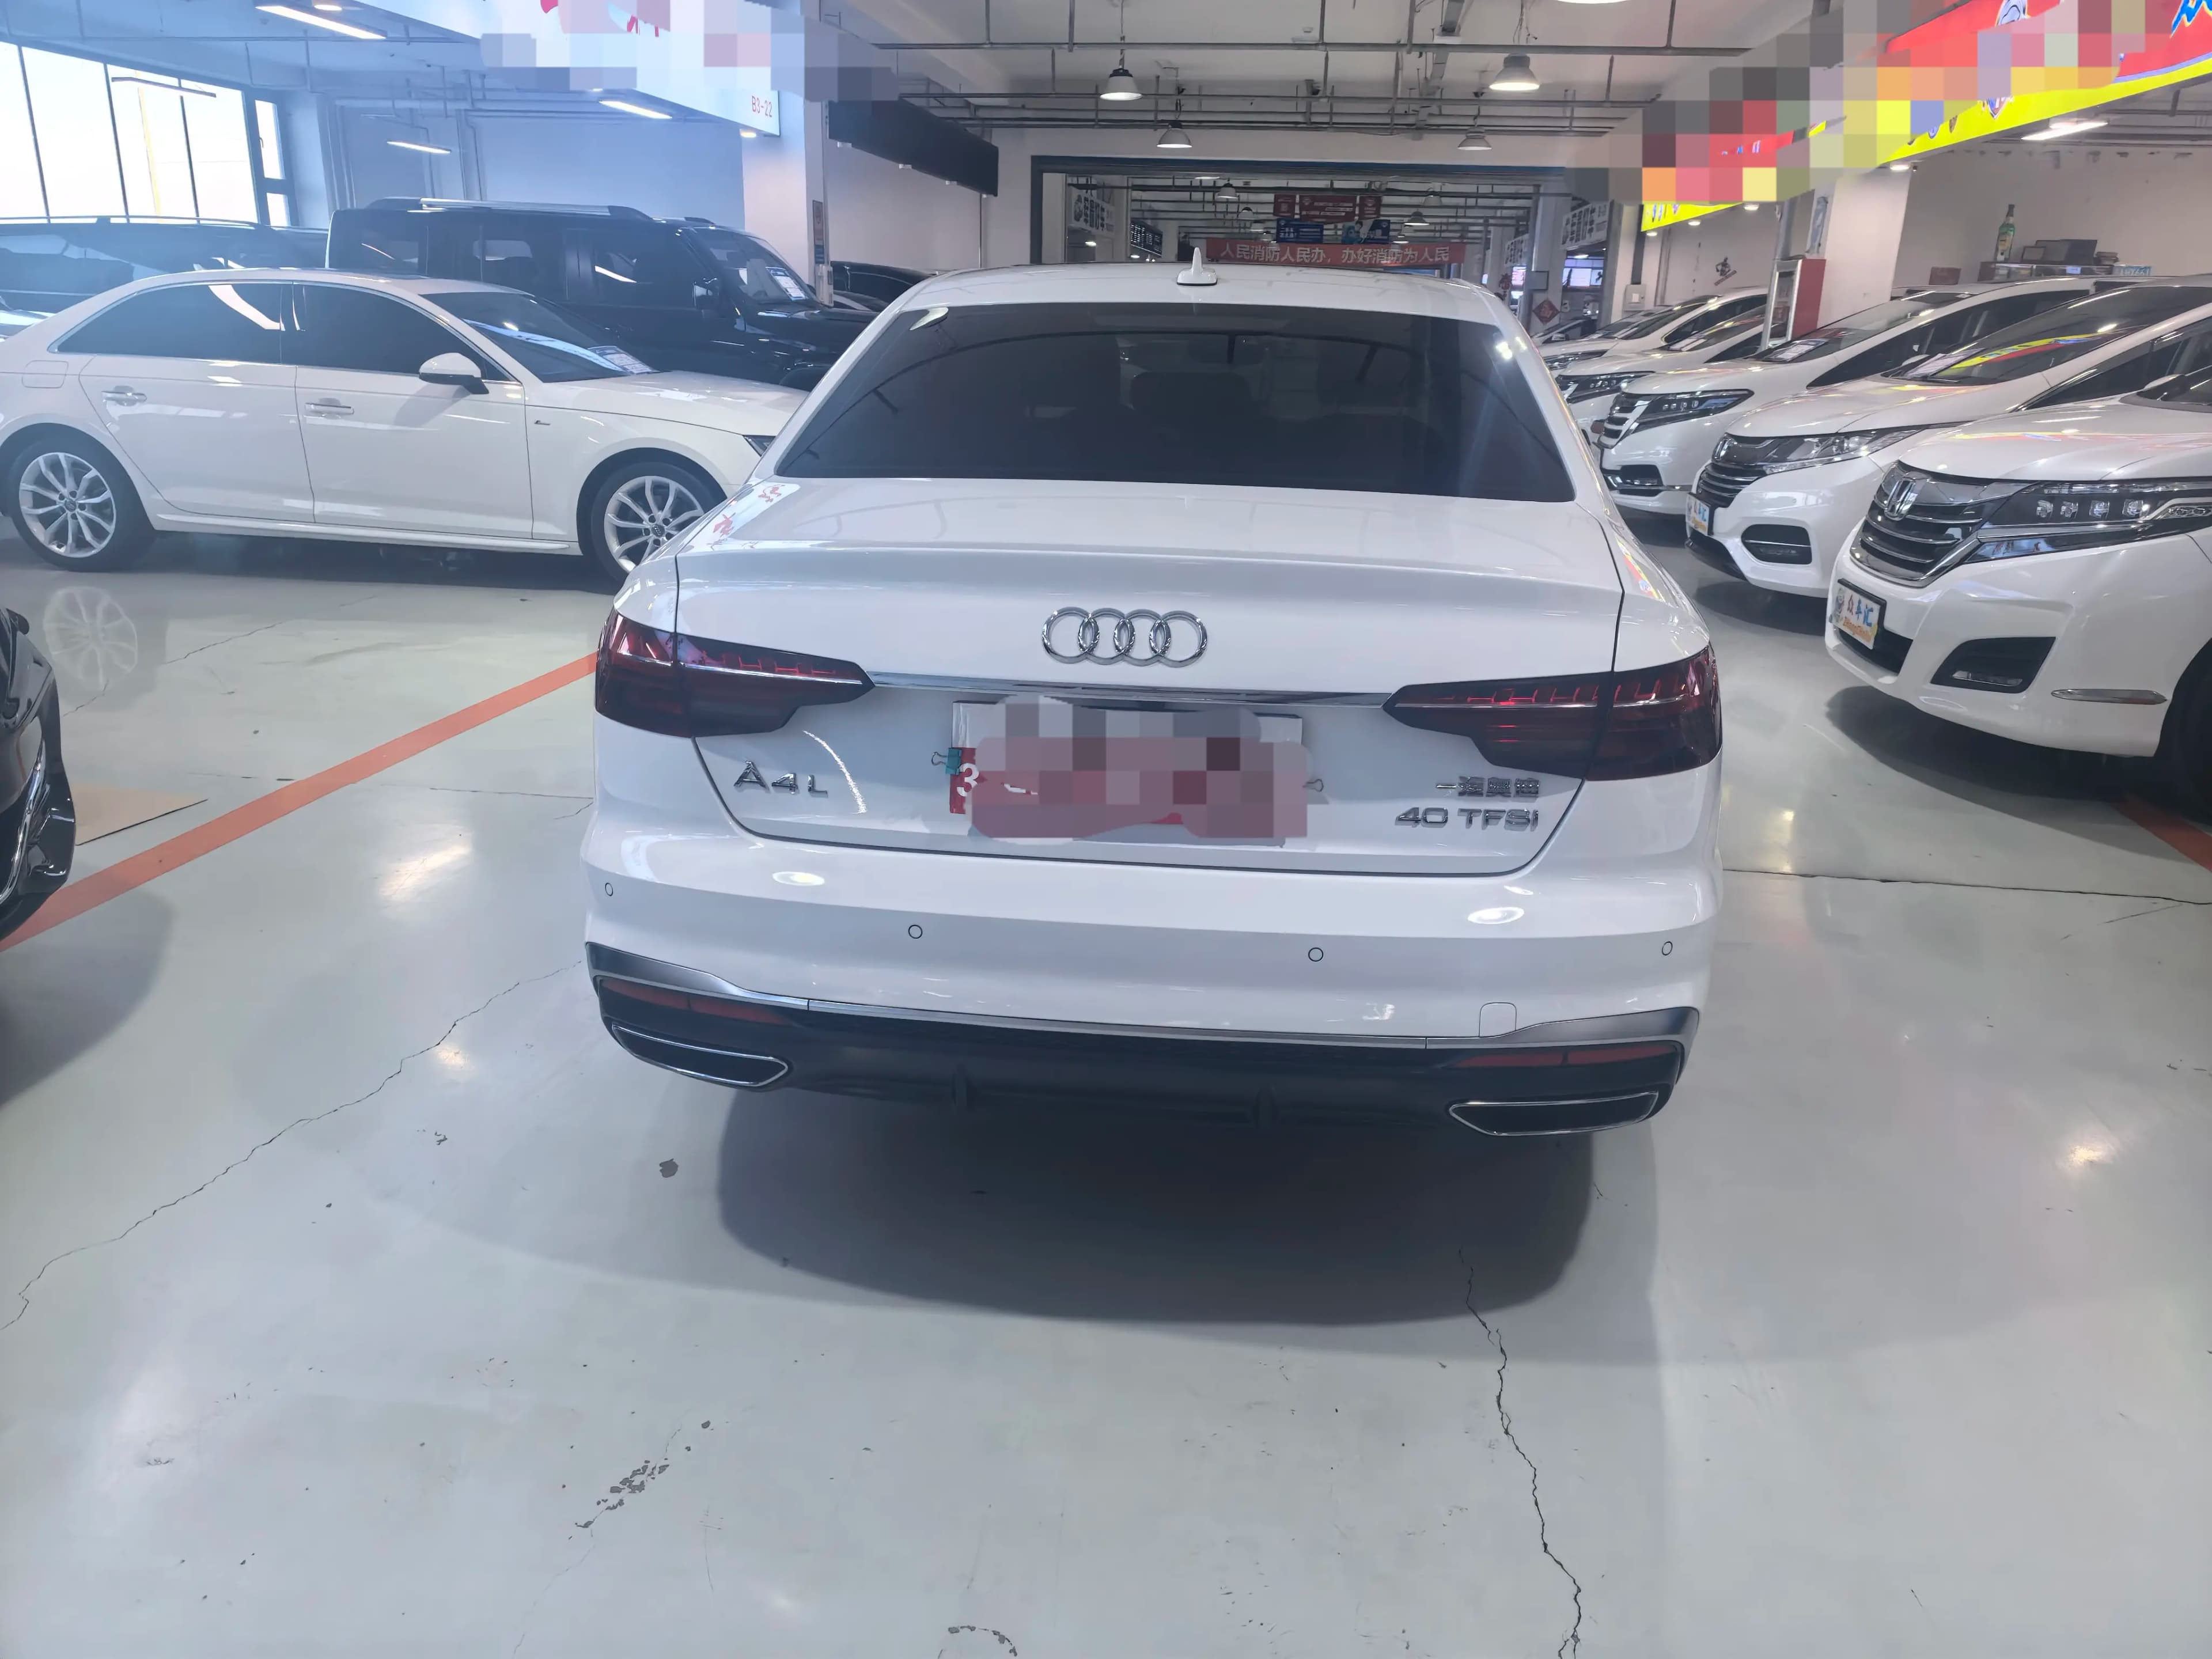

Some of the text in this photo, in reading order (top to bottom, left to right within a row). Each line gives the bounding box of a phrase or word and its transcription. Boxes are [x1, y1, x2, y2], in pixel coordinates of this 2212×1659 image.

[752, 96, 772, 118] B3-22
[1395, 806, 1539, 832] 40 TFSI
